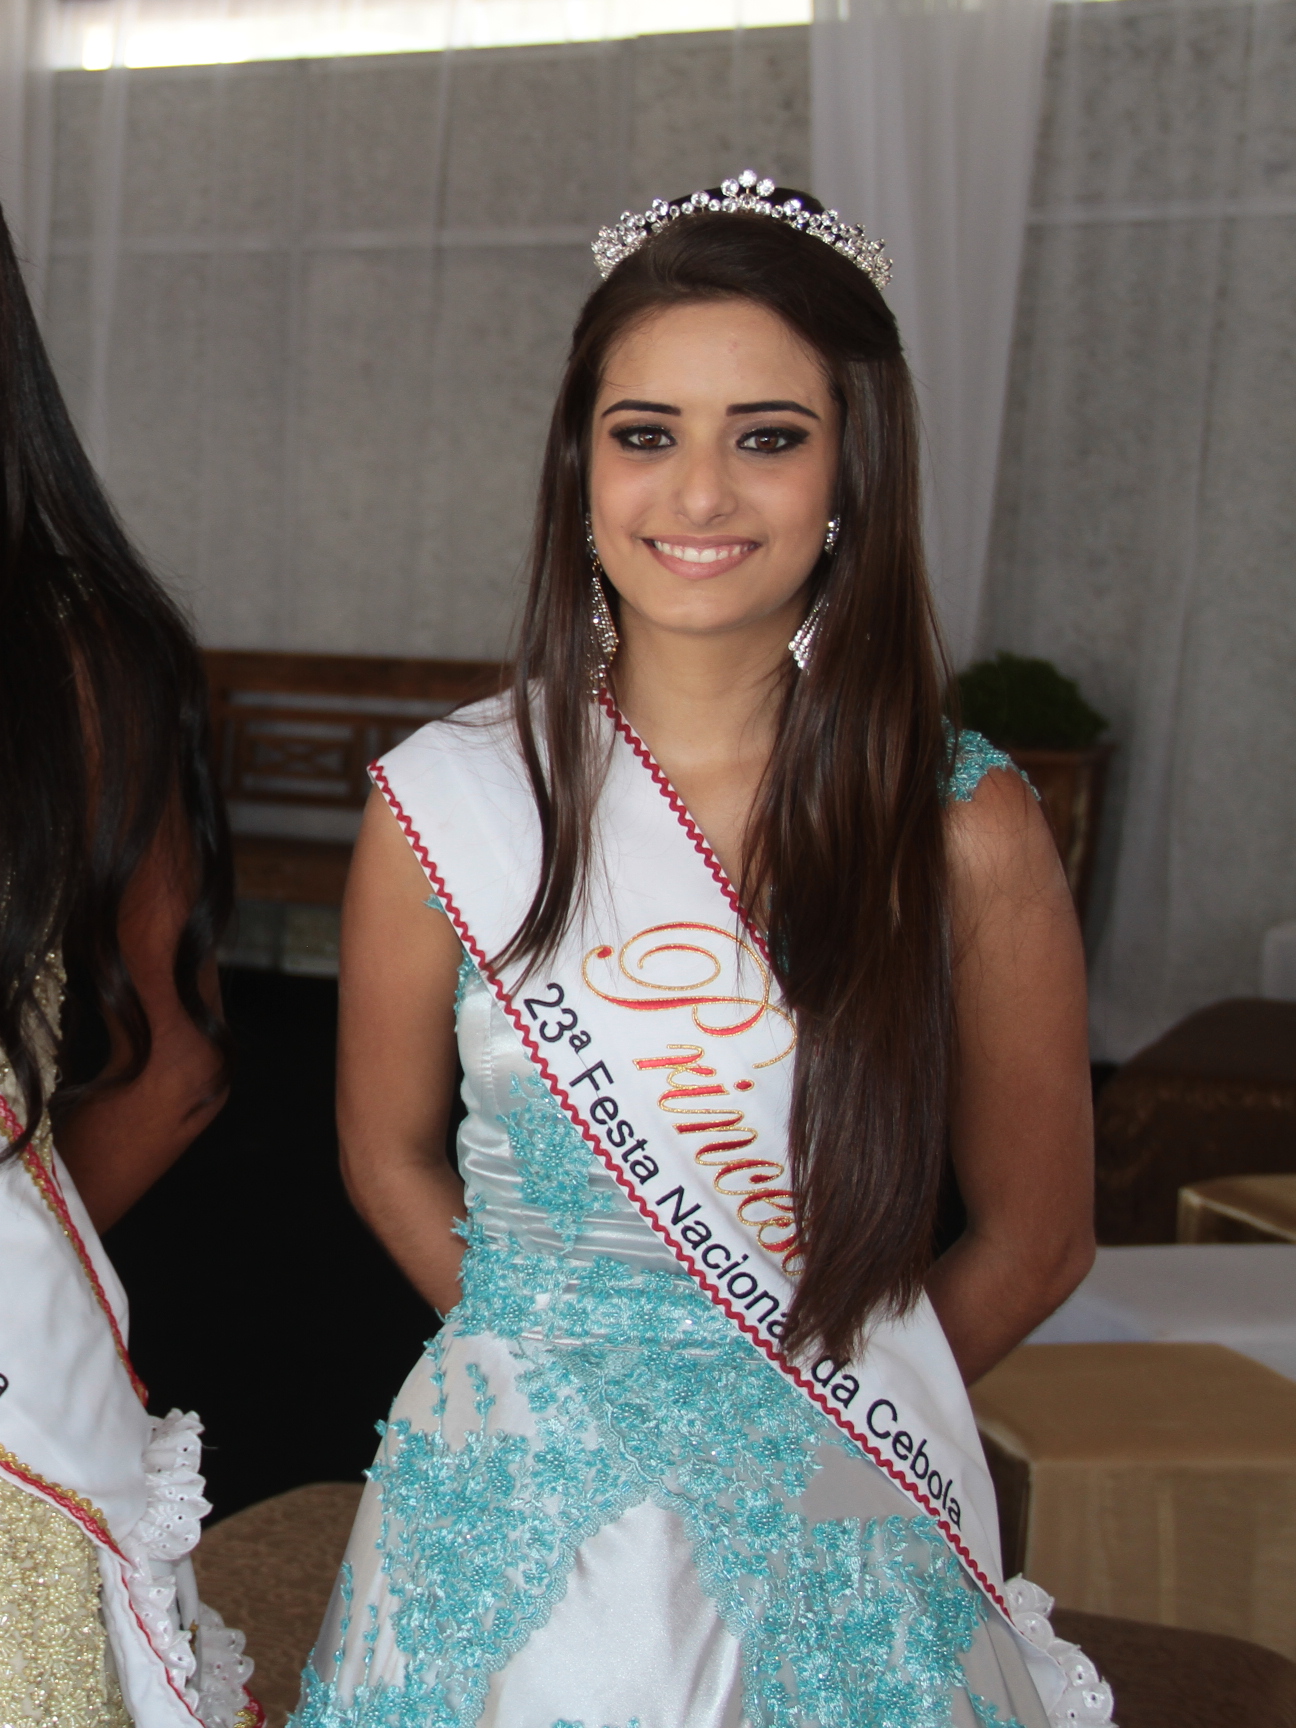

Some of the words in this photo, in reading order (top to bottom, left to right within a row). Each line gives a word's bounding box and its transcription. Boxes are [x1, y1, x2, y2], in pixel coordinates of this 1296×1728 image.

[568, 1059, 660, 1186] Festa
[654, 1184, 796, 1345] Naciona
[810, 1355, 861, 1409] da
[866, 1398, 963, 1532] Cebola
